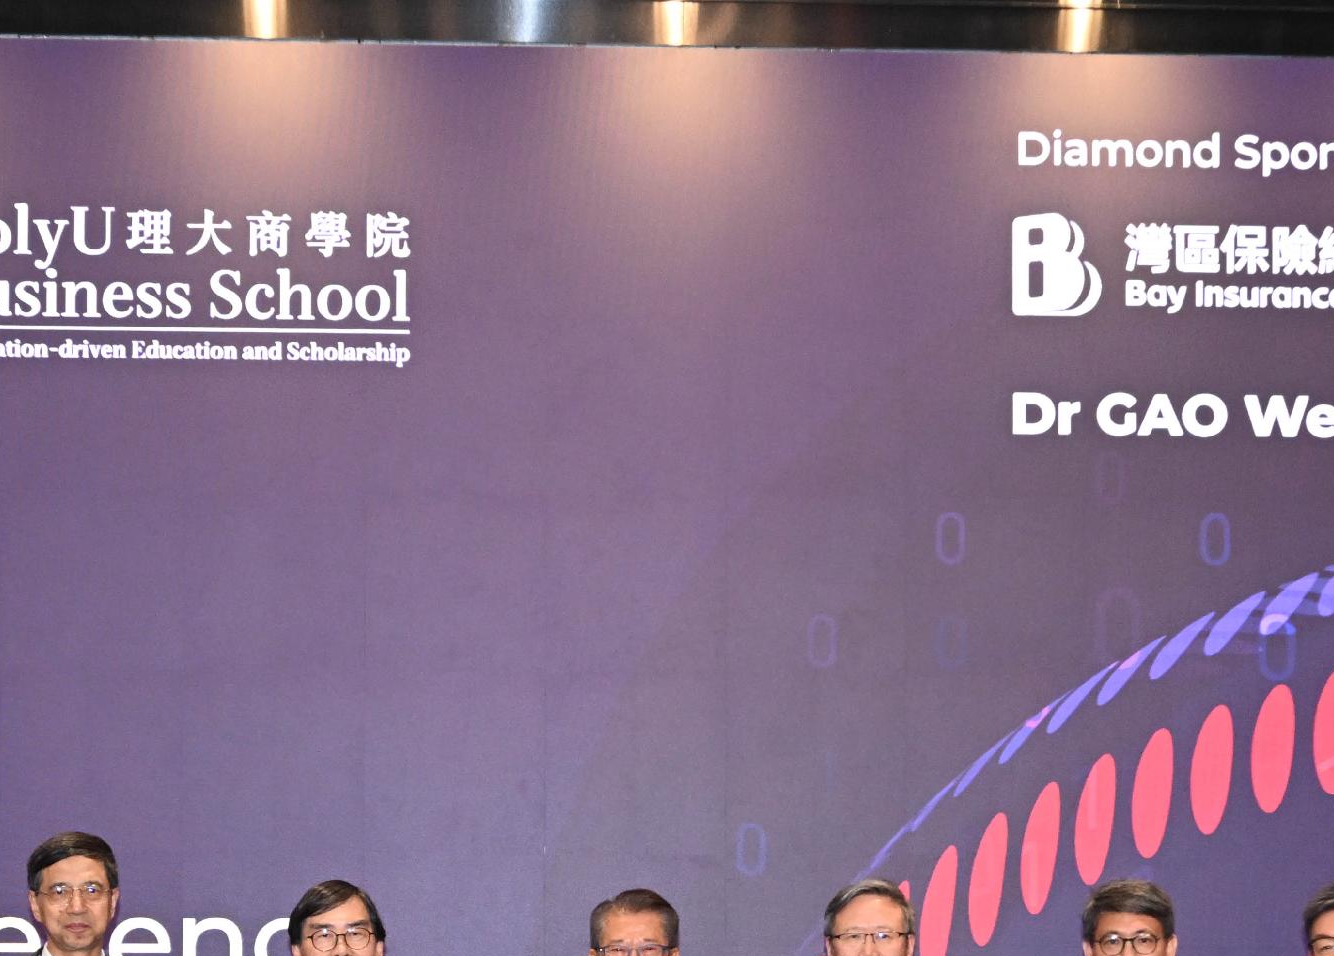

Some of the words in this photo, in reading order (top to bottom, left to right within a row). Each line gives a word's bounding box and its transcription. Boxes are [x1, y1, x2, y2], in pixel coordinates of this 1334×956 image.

[1017, 129, 1221, 169] Diamond
[125, 208, 411, 258] 理大商學院
[209, 267, 411, 322] School
[1125, 280, 1188, 314] Bay
[131, 339, 238, 360] Education
[241, 340, 283, 361] and
[286, 341, 411, 368] Scholarship
[1012, 391, 1082, 436] Dr
[1096, 393, 1229, 438] GAO
